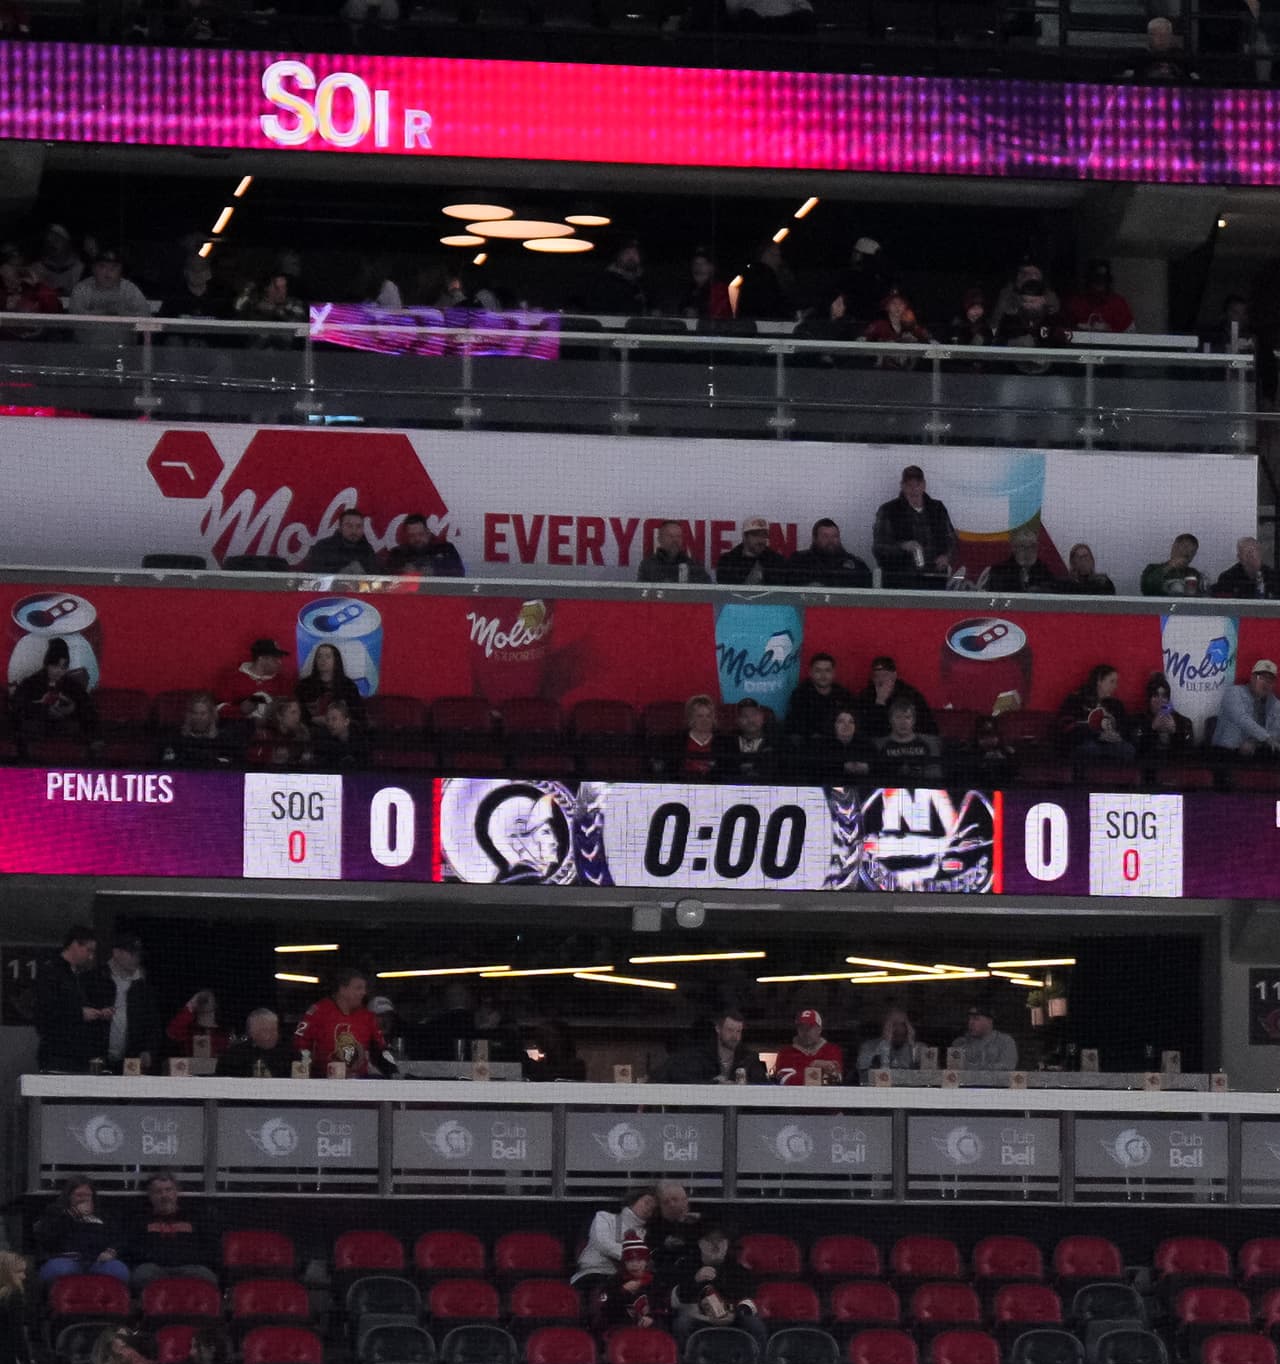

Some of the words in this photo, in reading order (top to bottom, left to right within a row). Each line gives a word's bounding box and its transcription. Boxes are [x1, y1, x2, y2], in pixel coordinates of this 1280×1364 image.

[467, 612, 550, 658] Molso
[717, 643, 800, 686] Molso
[1164, 648, 1234, 687] Molso
[46, 772, 174, 804] PENALTIES
[270, 791, 324, 822] SOG
[369, 786, 415, 867] 0
[643, 800, 807, 880] 0:00
[1105, 809, 1158, 840] SOG
[289, 830, 307, 863] 0
[1024, 802, 1069, 881] 0
[1122, 849, 1140, 881] 0
[142, 1134, 177, 1155] Bell
[317, 1137, 352, 1157] Bell
[491, 1139, 527, 1160] Bell
[663, 1141, 698, 1161] Bell
[831, 1144, 866, 1163] Bell
[1000, 1146, 1035, 1166] Bell
[1169, 1148, 1203, 1168] Bell
